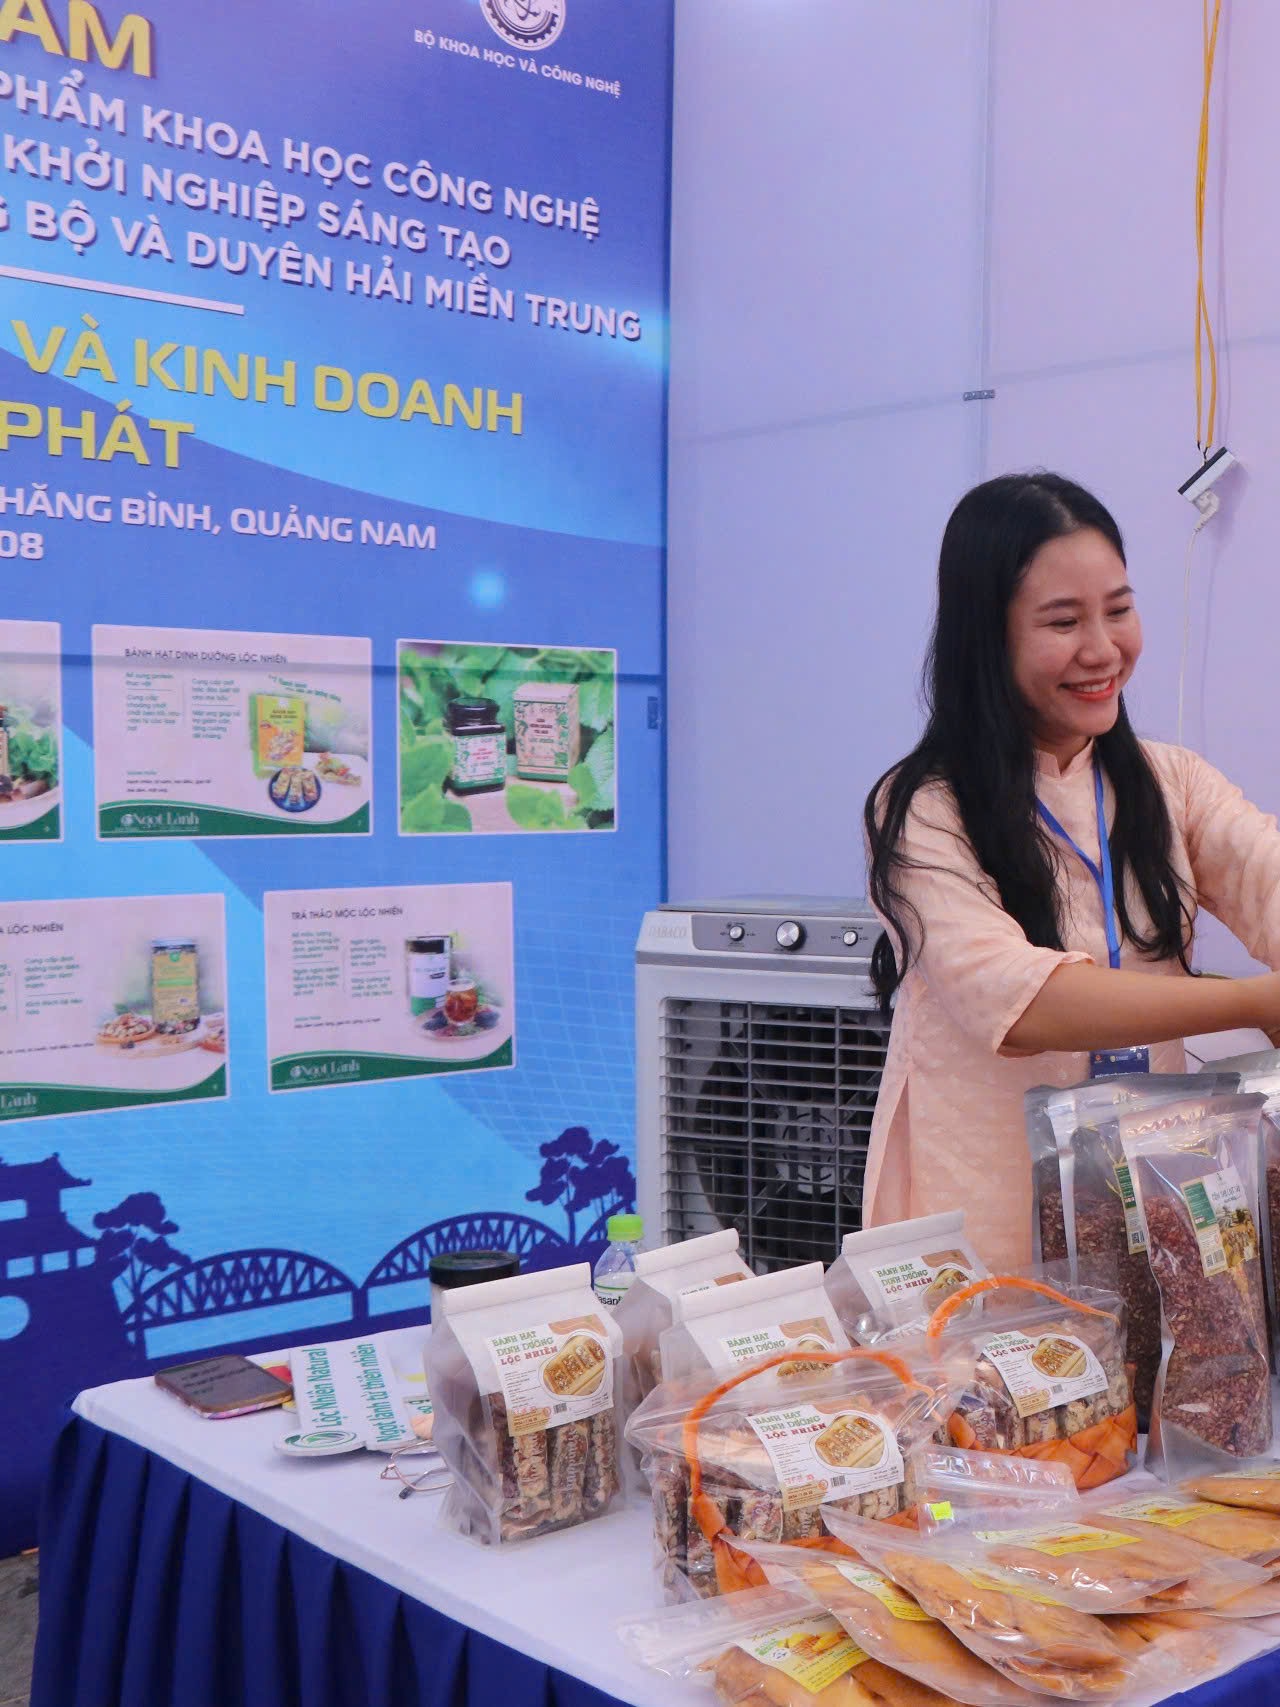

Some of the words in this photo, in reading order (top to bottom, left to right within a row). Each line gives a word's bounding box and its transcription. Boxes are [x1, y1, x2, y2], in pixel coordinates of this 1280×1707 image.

[414, 29, 434, 49] BỘ
[439, 37, 479, 59] KHOA
[483, 47, 515, 69] HỌC
[518, 58, 538, 75] VÀ
[541, 65, 582, 86] CÔNG
[585, 75, 621, 98] NGHỆ
[4, 134, 126, 195] KHỞI
[142, 163, 306, 231] NGHIỆP
[317, 199, 427, 252] SÁNG
[438, 225, 511, 270] TẠO
[142, 104, 270, 166] KHOA
[283, 137, 371, 188] HỌC
[383, 159, 493, 212] CÔNG
[504, 187, 600, 241] NGHỆ
[26, 199, 97, 256] BỘ
[111, 214, 174, 263] VÀ
[187, 231, 333, 290] DUYÊN
[346, 255, 413, 305] HẢI
[425, 271, 514, 321] MIỀN
[525, 292, 642, 341] TRUNG
[10, 313, 118, 384] VÀ
[134, 338, 297, 408] KINH
[314, 365, 523, 436] DOANH
[0, 399, 196, 469] PHÁT
[121, 490, 221, 536] BÌNH,
[230, 504, 353, 543] QUẢNG
[361, 518, 437, 550] NAM
[301, 1348, 332, 1382] Natural
[500, 1353, 522, 1366] LỘC
[525, 1345, 558, 1360] NHIÊN
[306, 1383, 338, 1410] Nhiên
[765, 1429, 787, 1441] LỘC
[791, 1422, 826, 1436] NHIÊN
